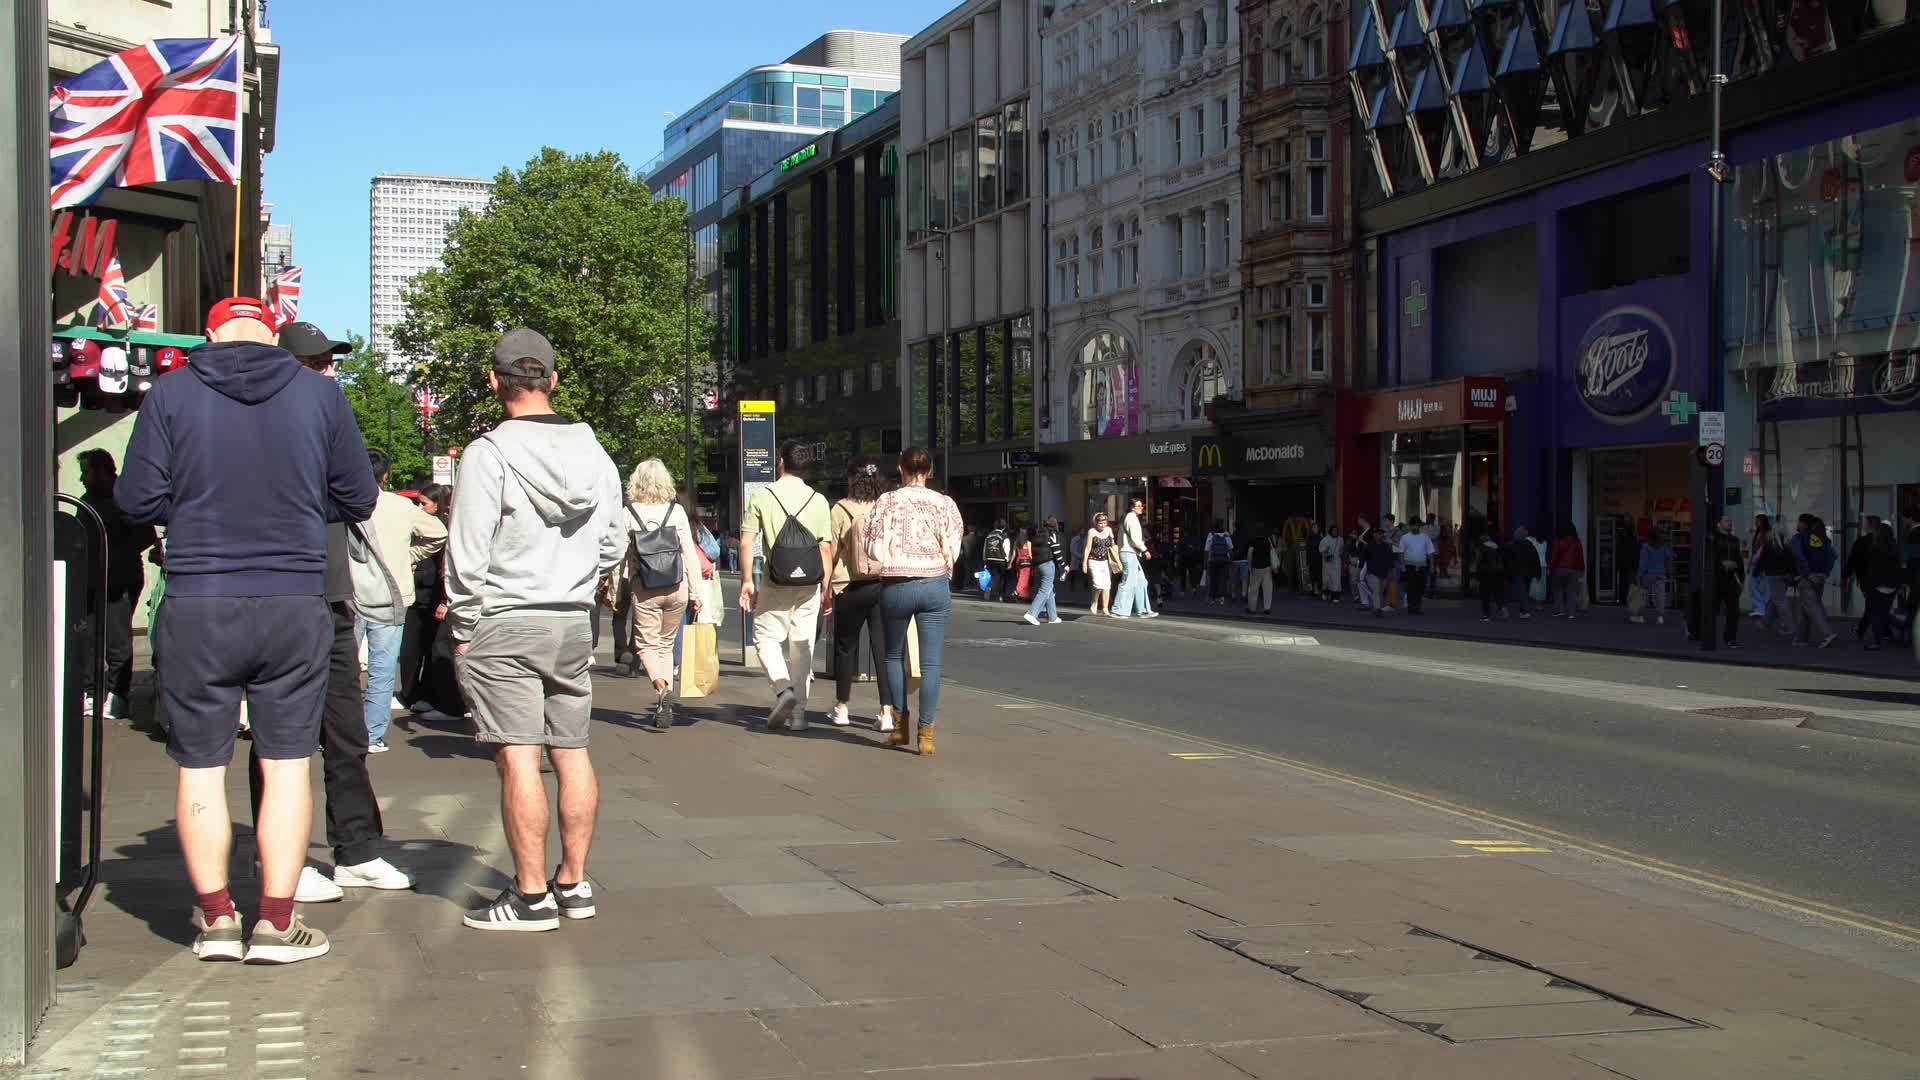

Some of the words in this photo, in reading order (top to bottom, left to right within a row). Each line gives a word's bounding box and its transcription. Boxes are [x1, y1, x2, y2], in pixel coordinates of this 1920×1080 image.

[1583, 328, 1648, 398] Boots
[1471, 388, 1496, 402] MUJI
[1397, 398, 1422, 421] MUJI
[1246, 444, 1304, 462] McDonald's
[1708, 449, 1722, 460] 20
